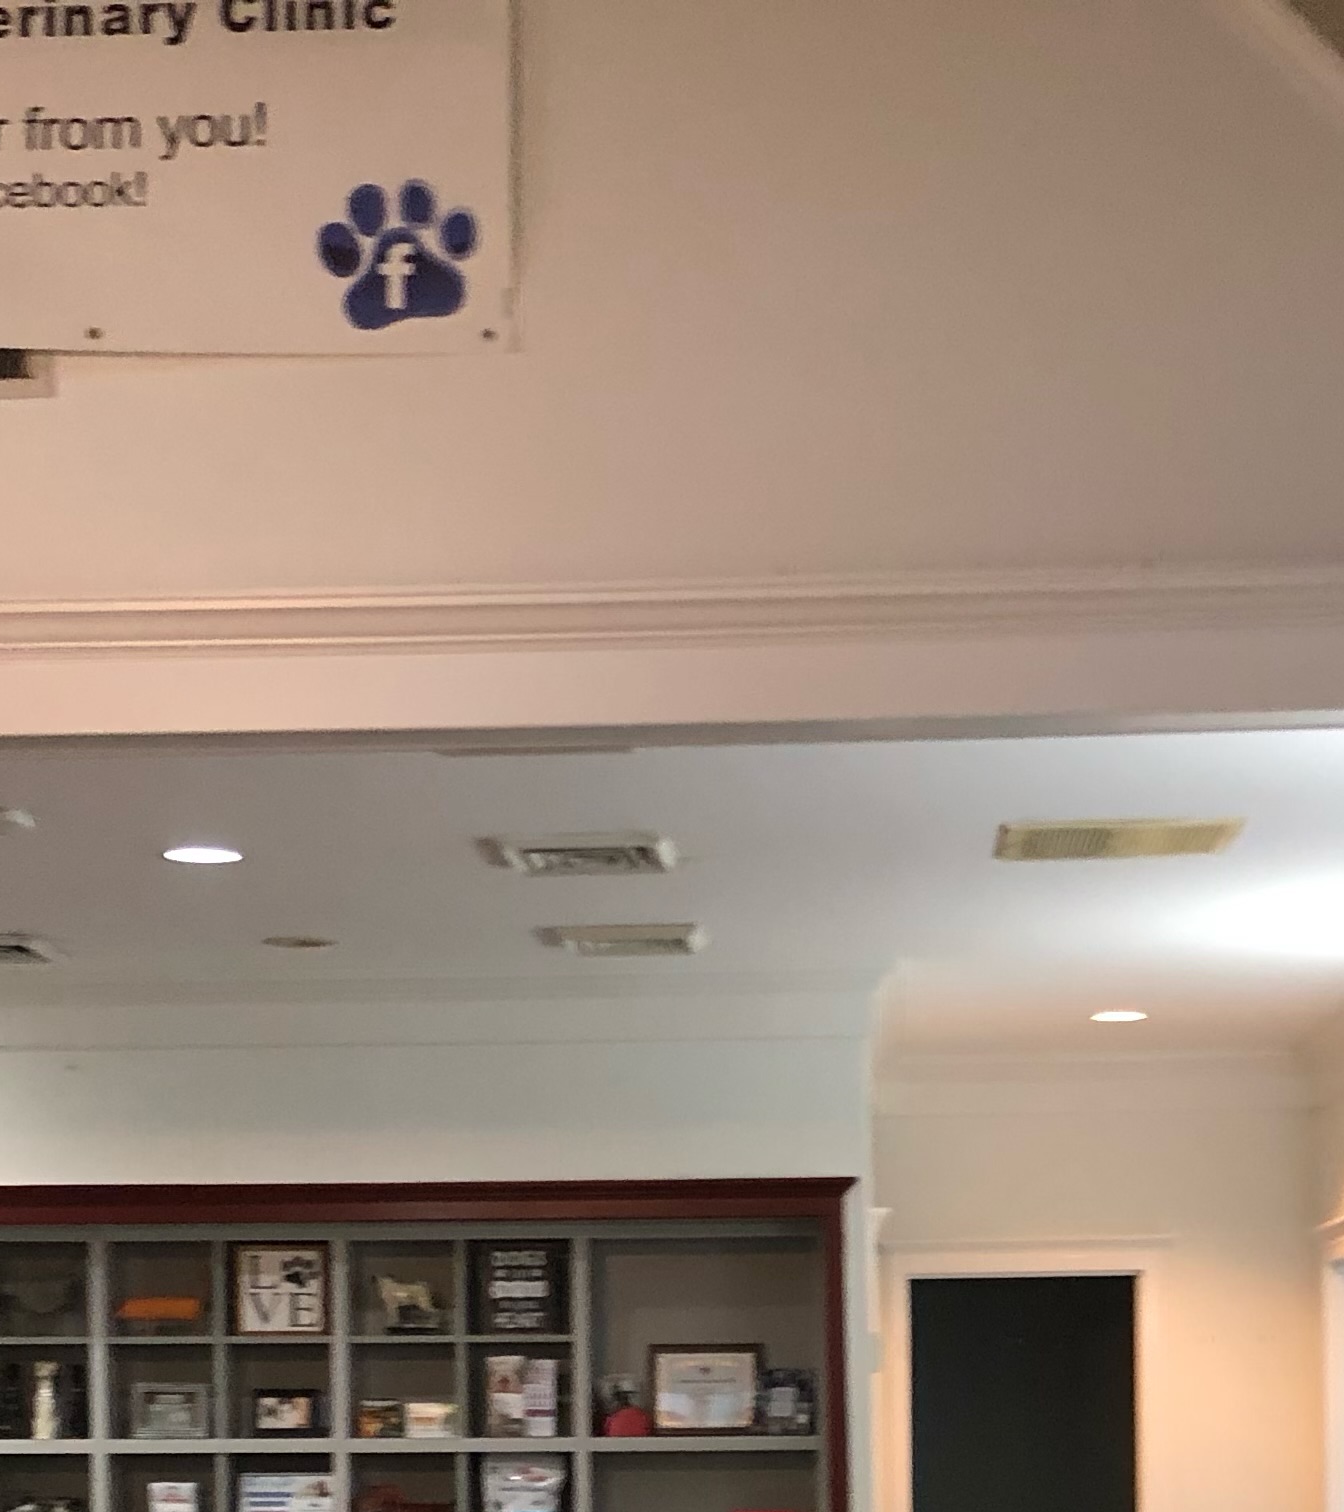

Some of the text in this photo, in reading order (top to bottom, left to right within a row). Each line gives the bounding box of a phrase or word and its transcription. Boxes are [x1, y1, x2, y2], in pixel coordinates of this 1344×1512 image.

[220, 0, 396, 32] Clinic
[24, 106, 142, 151] from
[156, 102, 268, 161] you!
